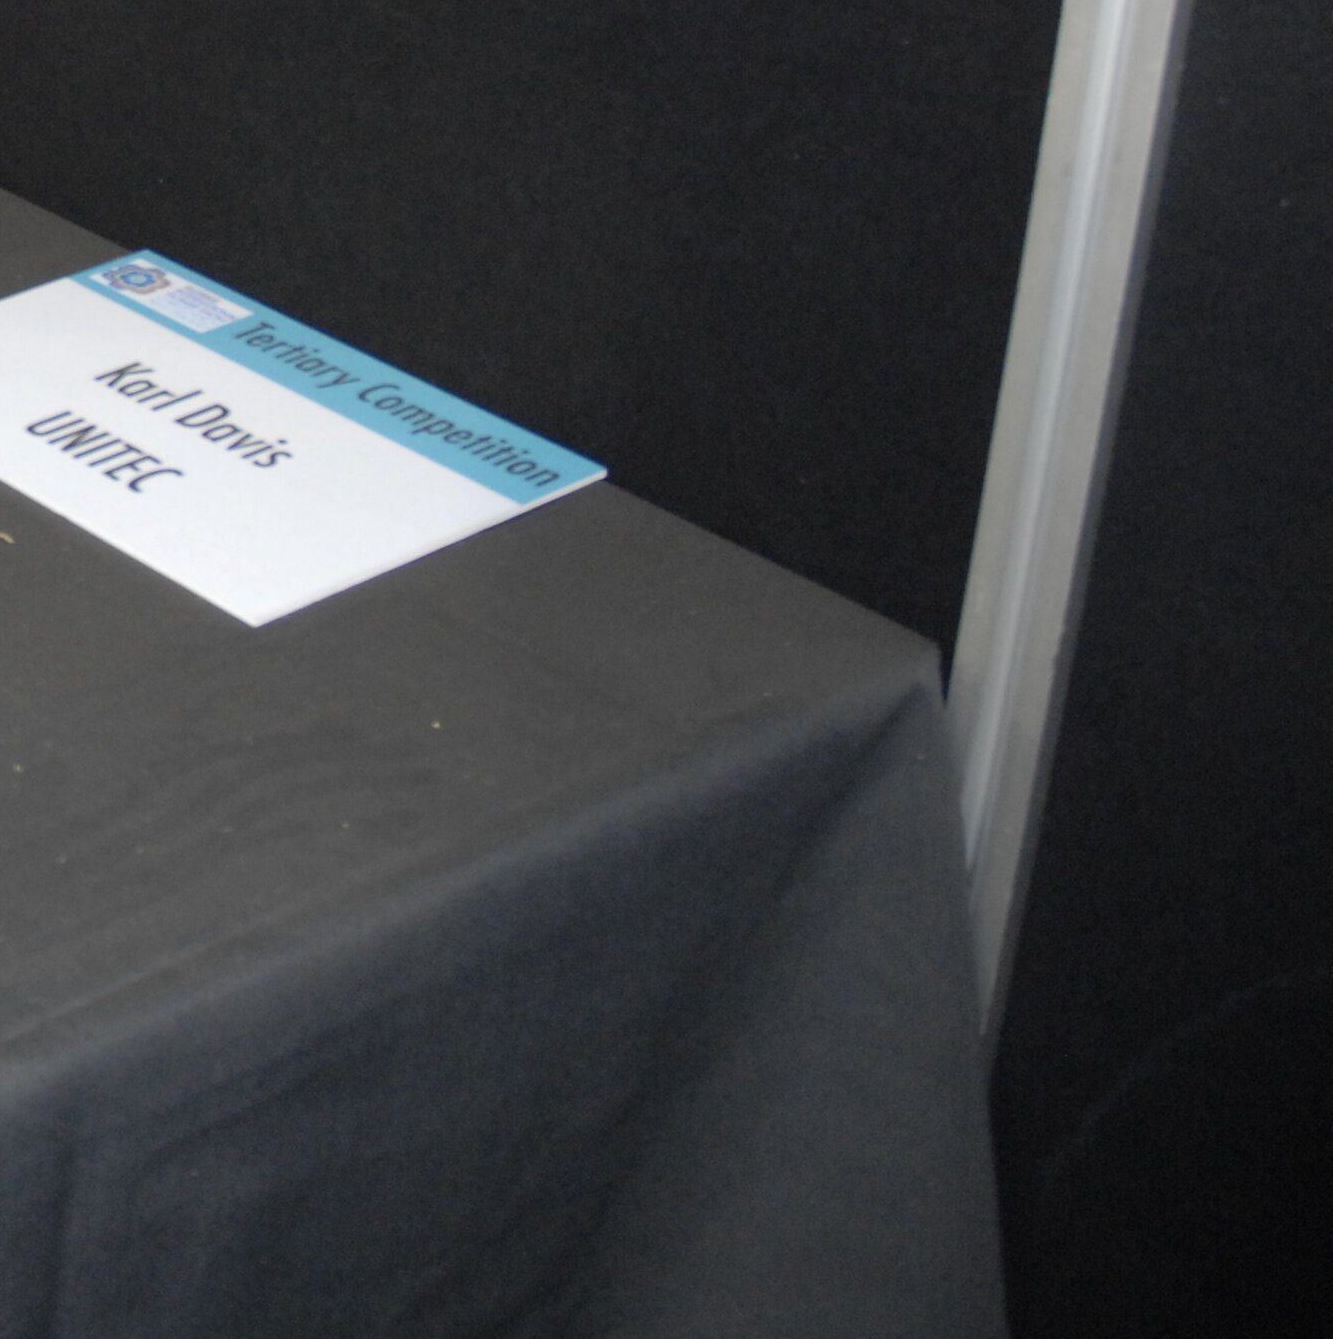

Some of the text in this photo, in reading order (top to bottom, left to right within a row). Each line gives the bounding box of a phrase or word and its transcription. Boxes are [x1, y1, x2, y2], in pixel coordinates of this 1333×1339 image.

[25, 410, 185, 494] UNITEC
[95, 361, 293, 469] Karl Davis
[234, 322, 561, 487] Tertiary Competition
